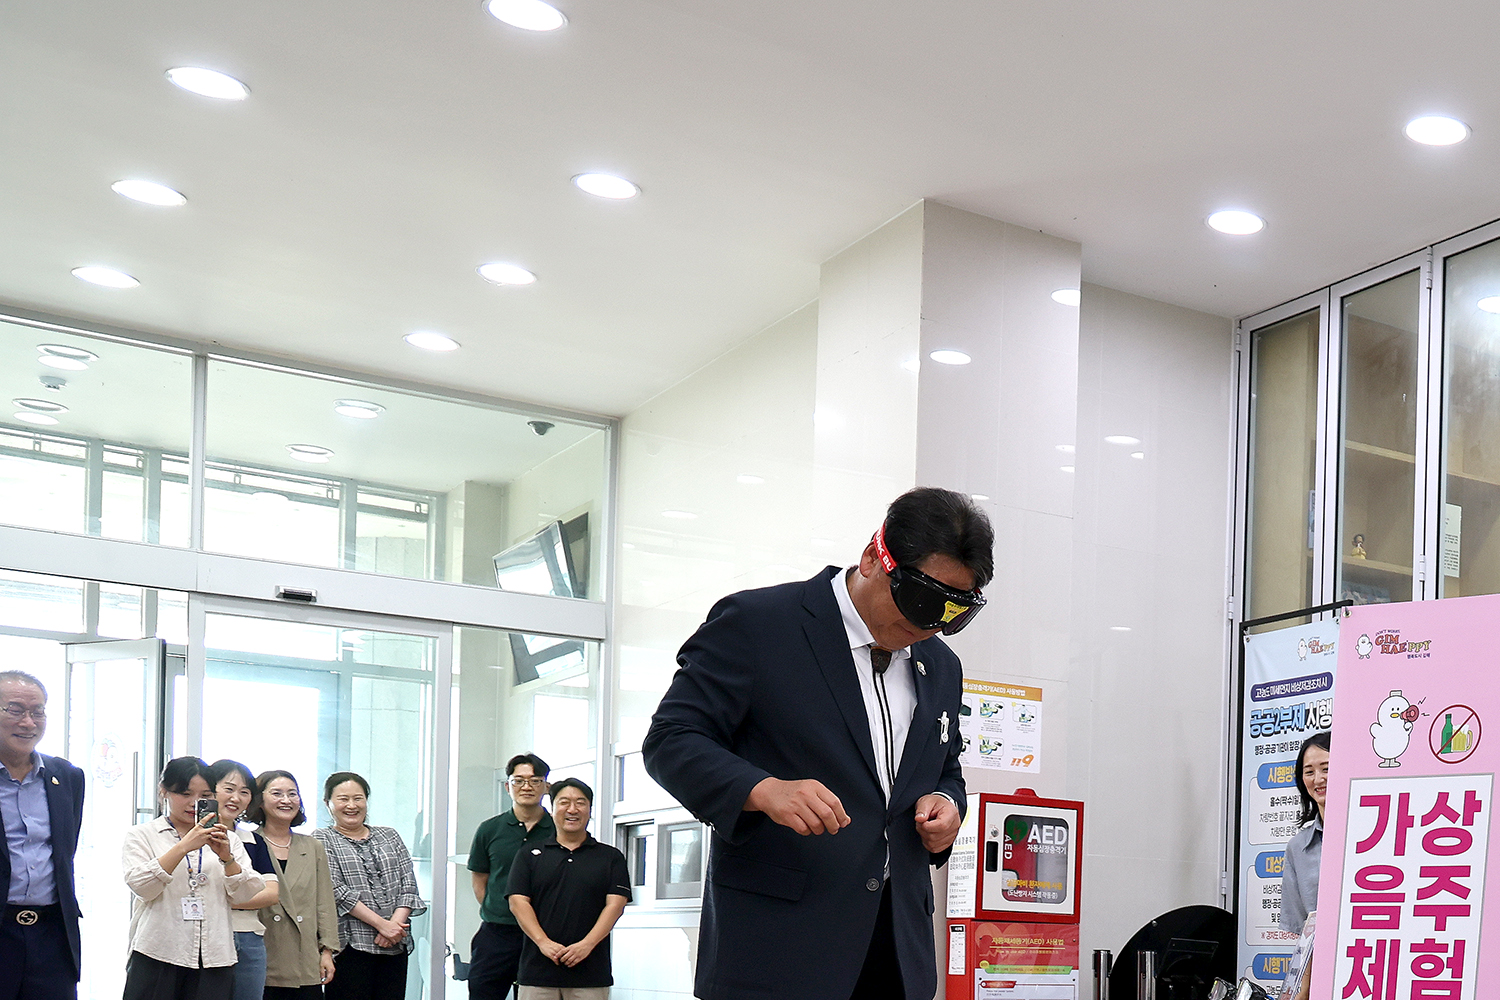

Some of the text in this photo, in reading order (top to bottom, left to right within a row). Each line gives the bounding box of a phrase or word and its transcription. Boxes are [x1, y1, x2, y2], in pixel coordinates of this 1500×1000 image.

[1375, 634, 1400, 646] GIM
[1250, 697, 1333, 738] 공공2부제 시행
[1010, 754, 1034, 768] 119
[1267, 766, 1296, 783] 시행방
[1355, 790, 1482, 856] 가상
[1027, 824, 1067, 845] AED
[1004, 834, 1013, 859] AED
[1027, 844, 1066, 855] 자동심장충격기
[1265, 857, 1285, 873] 대상
[1350, 864, 1471, 931] 음주
